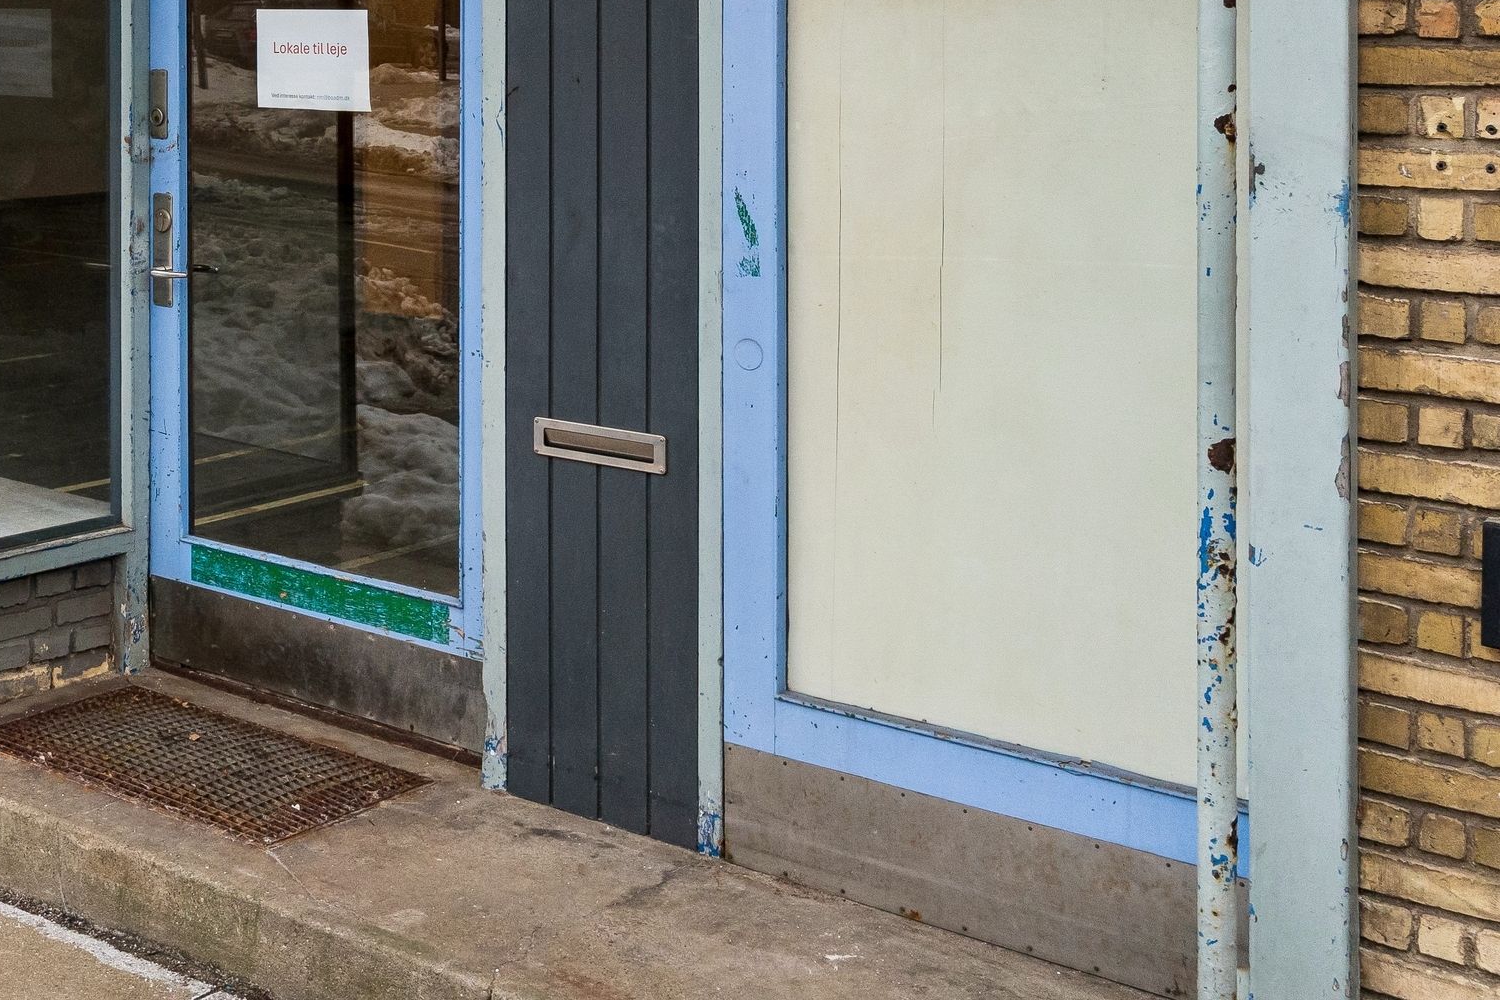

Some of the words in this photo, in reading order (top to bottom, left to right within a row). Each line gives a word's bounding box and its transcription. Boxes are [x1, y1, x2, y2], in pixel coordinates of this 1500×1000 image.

[273, 41, 310, 55] Lokale
[313, 42, 324, 55] til
[326, 42, 348, 58] leje
